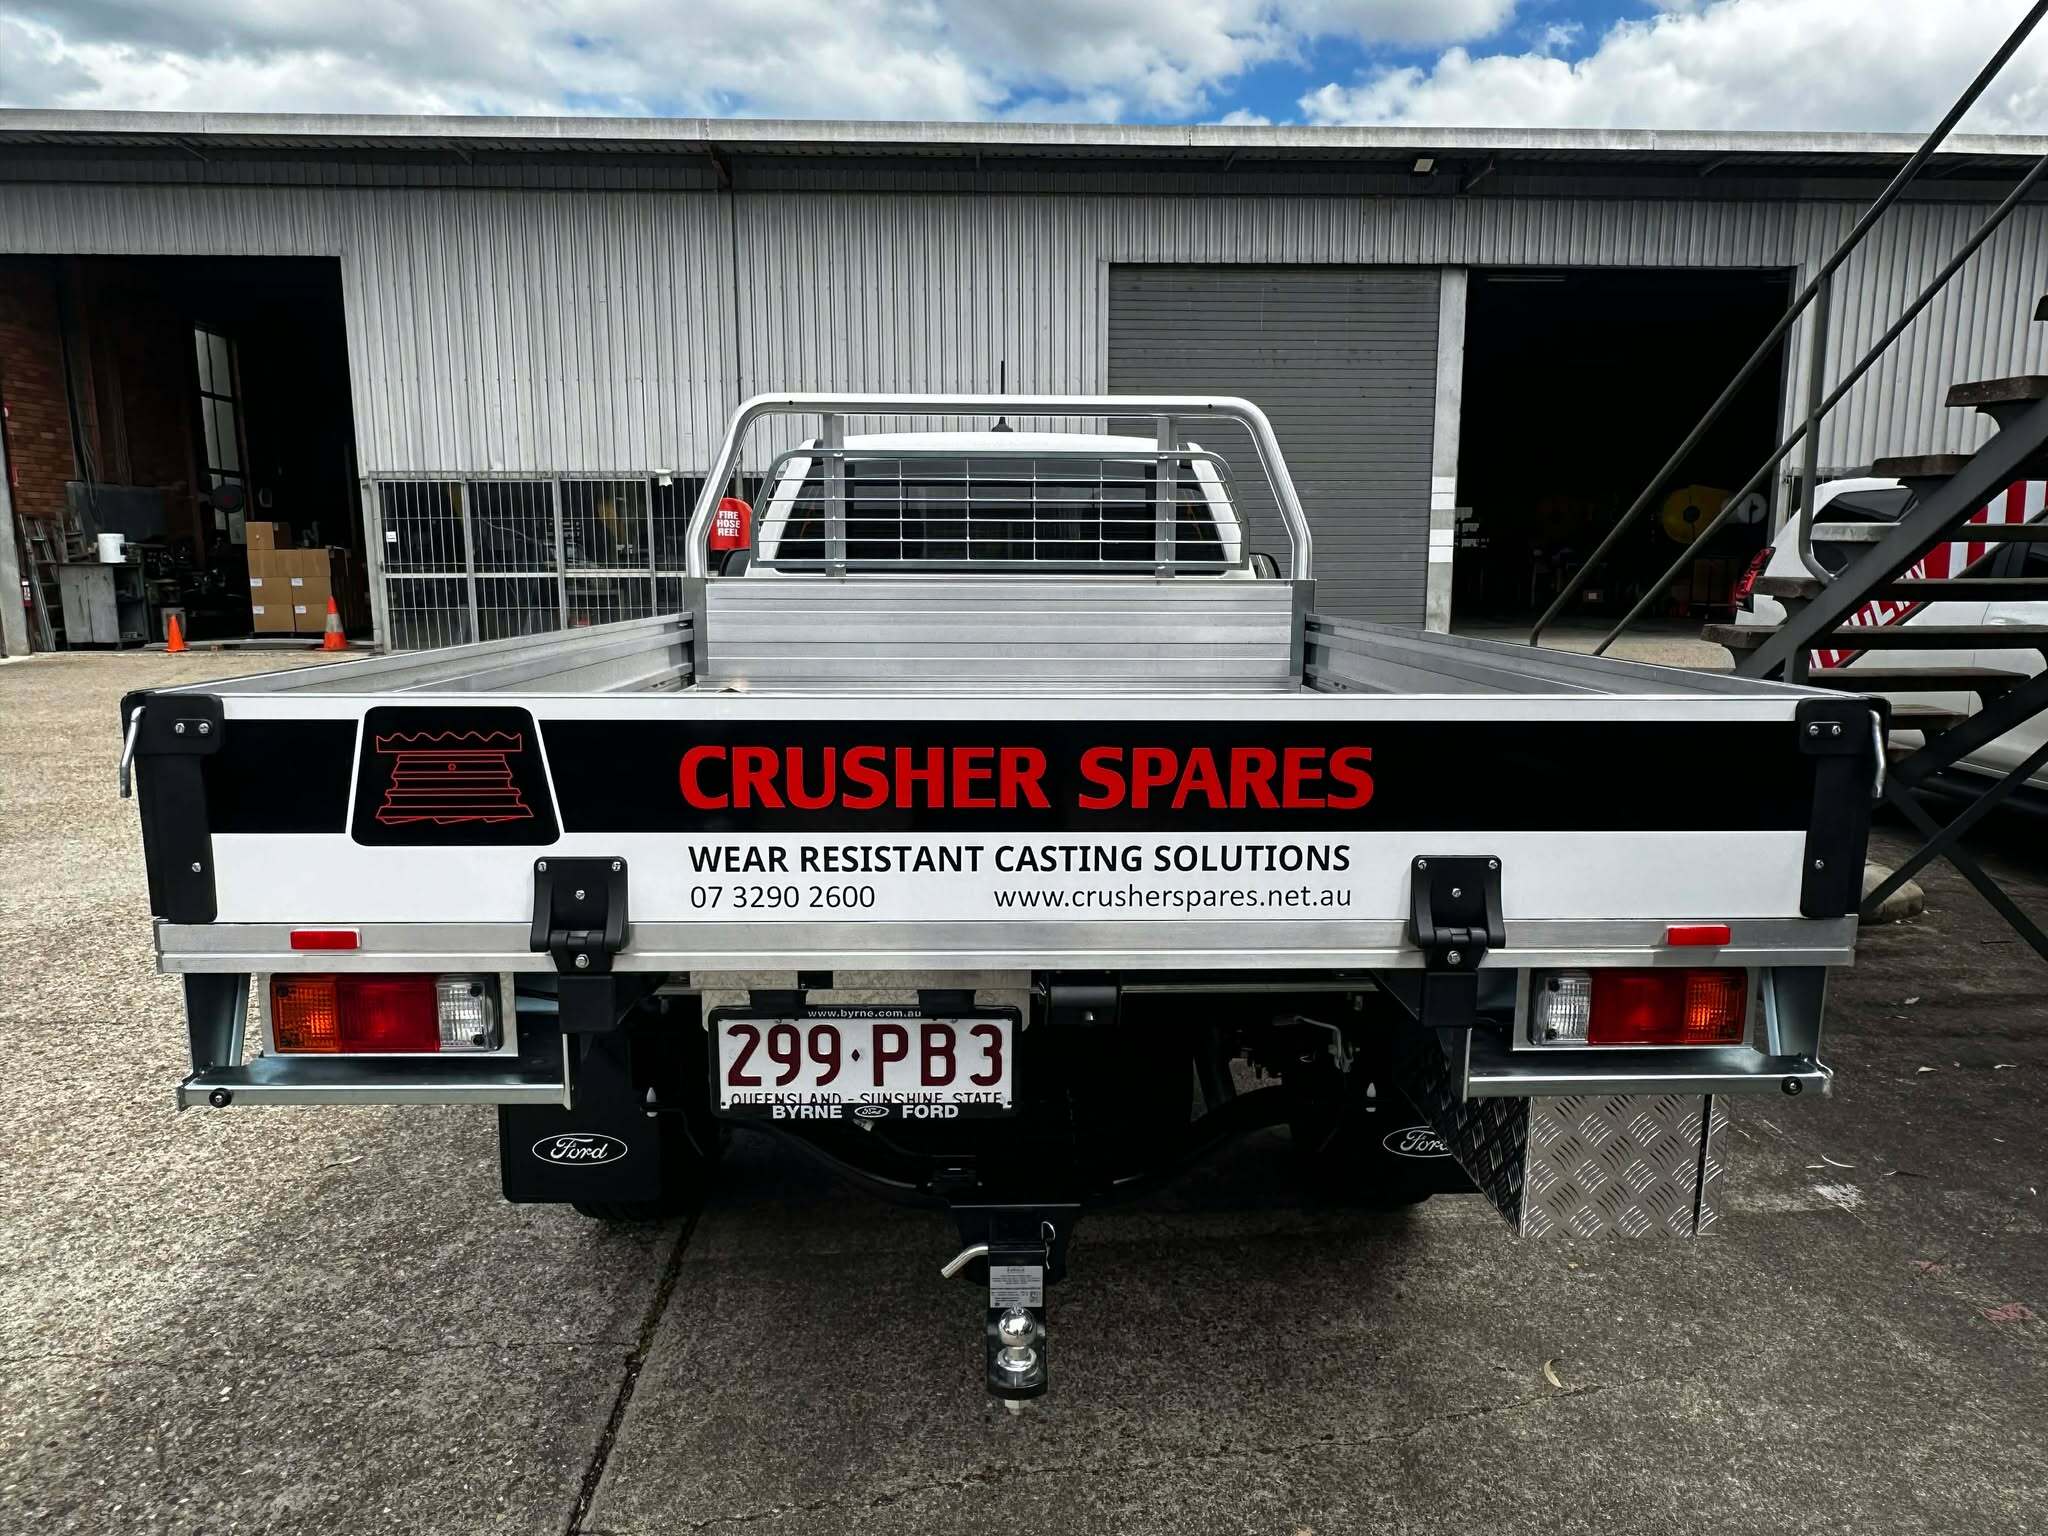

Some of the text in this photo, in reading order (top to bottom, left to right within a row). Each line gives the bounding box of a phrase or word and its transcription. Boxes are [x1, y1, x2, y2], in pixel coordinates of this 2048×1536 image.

[717, 520, 740, 528] HOSE
[719, 511, 739, 519] FIRE
[718, 529, 739, 537] REEL
[679, 746, 1374, 810] CRUSHER SPARES
[688, 845, 1350, 872] WEAR RESISTANT CASTING SOLUTIONS
[690, 886, 875, 908] 07 3290 2600
[994, 884, 1351, 912] www.crusherspares.net.au
[807, 1009, 922, 1018] www.byrne.com.au
[772, 1105, 843, 1119] BYRNE
[902, 1105, 959, 1119] FORD
[550, 1137, 608, 1159] Ford
